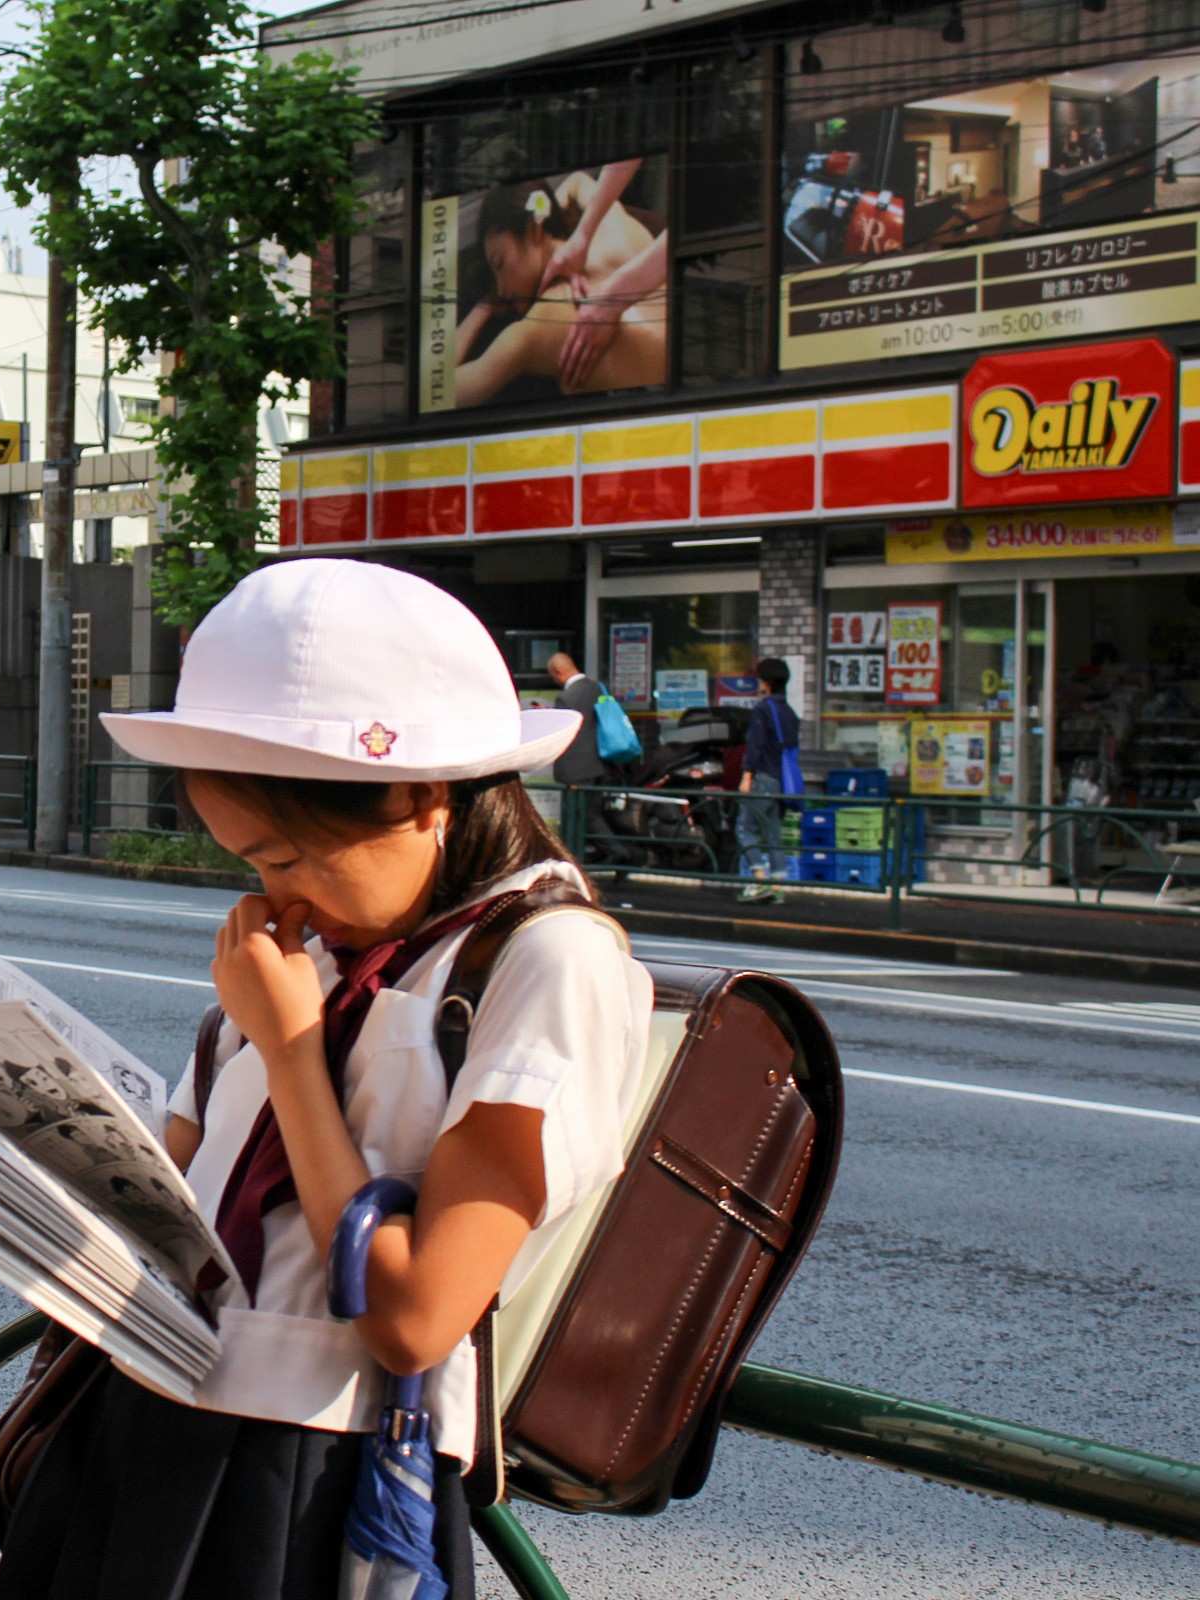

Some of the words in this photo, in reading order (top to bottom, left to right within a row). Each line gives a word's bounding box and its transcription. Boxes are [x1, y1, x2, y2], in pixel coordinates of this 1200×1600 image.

[1026, 236, 1148, 267] リフレクソロジー
[848, 270, 913, 295] ボディケア
[1041, 271, 1129, 300] 酸素カプセル
[818, 297, 946, 329] アロマトリートメント
[971, 379, 1157, 474] Daily
[1021, 447, 1105, 471] YAMAZAKI
